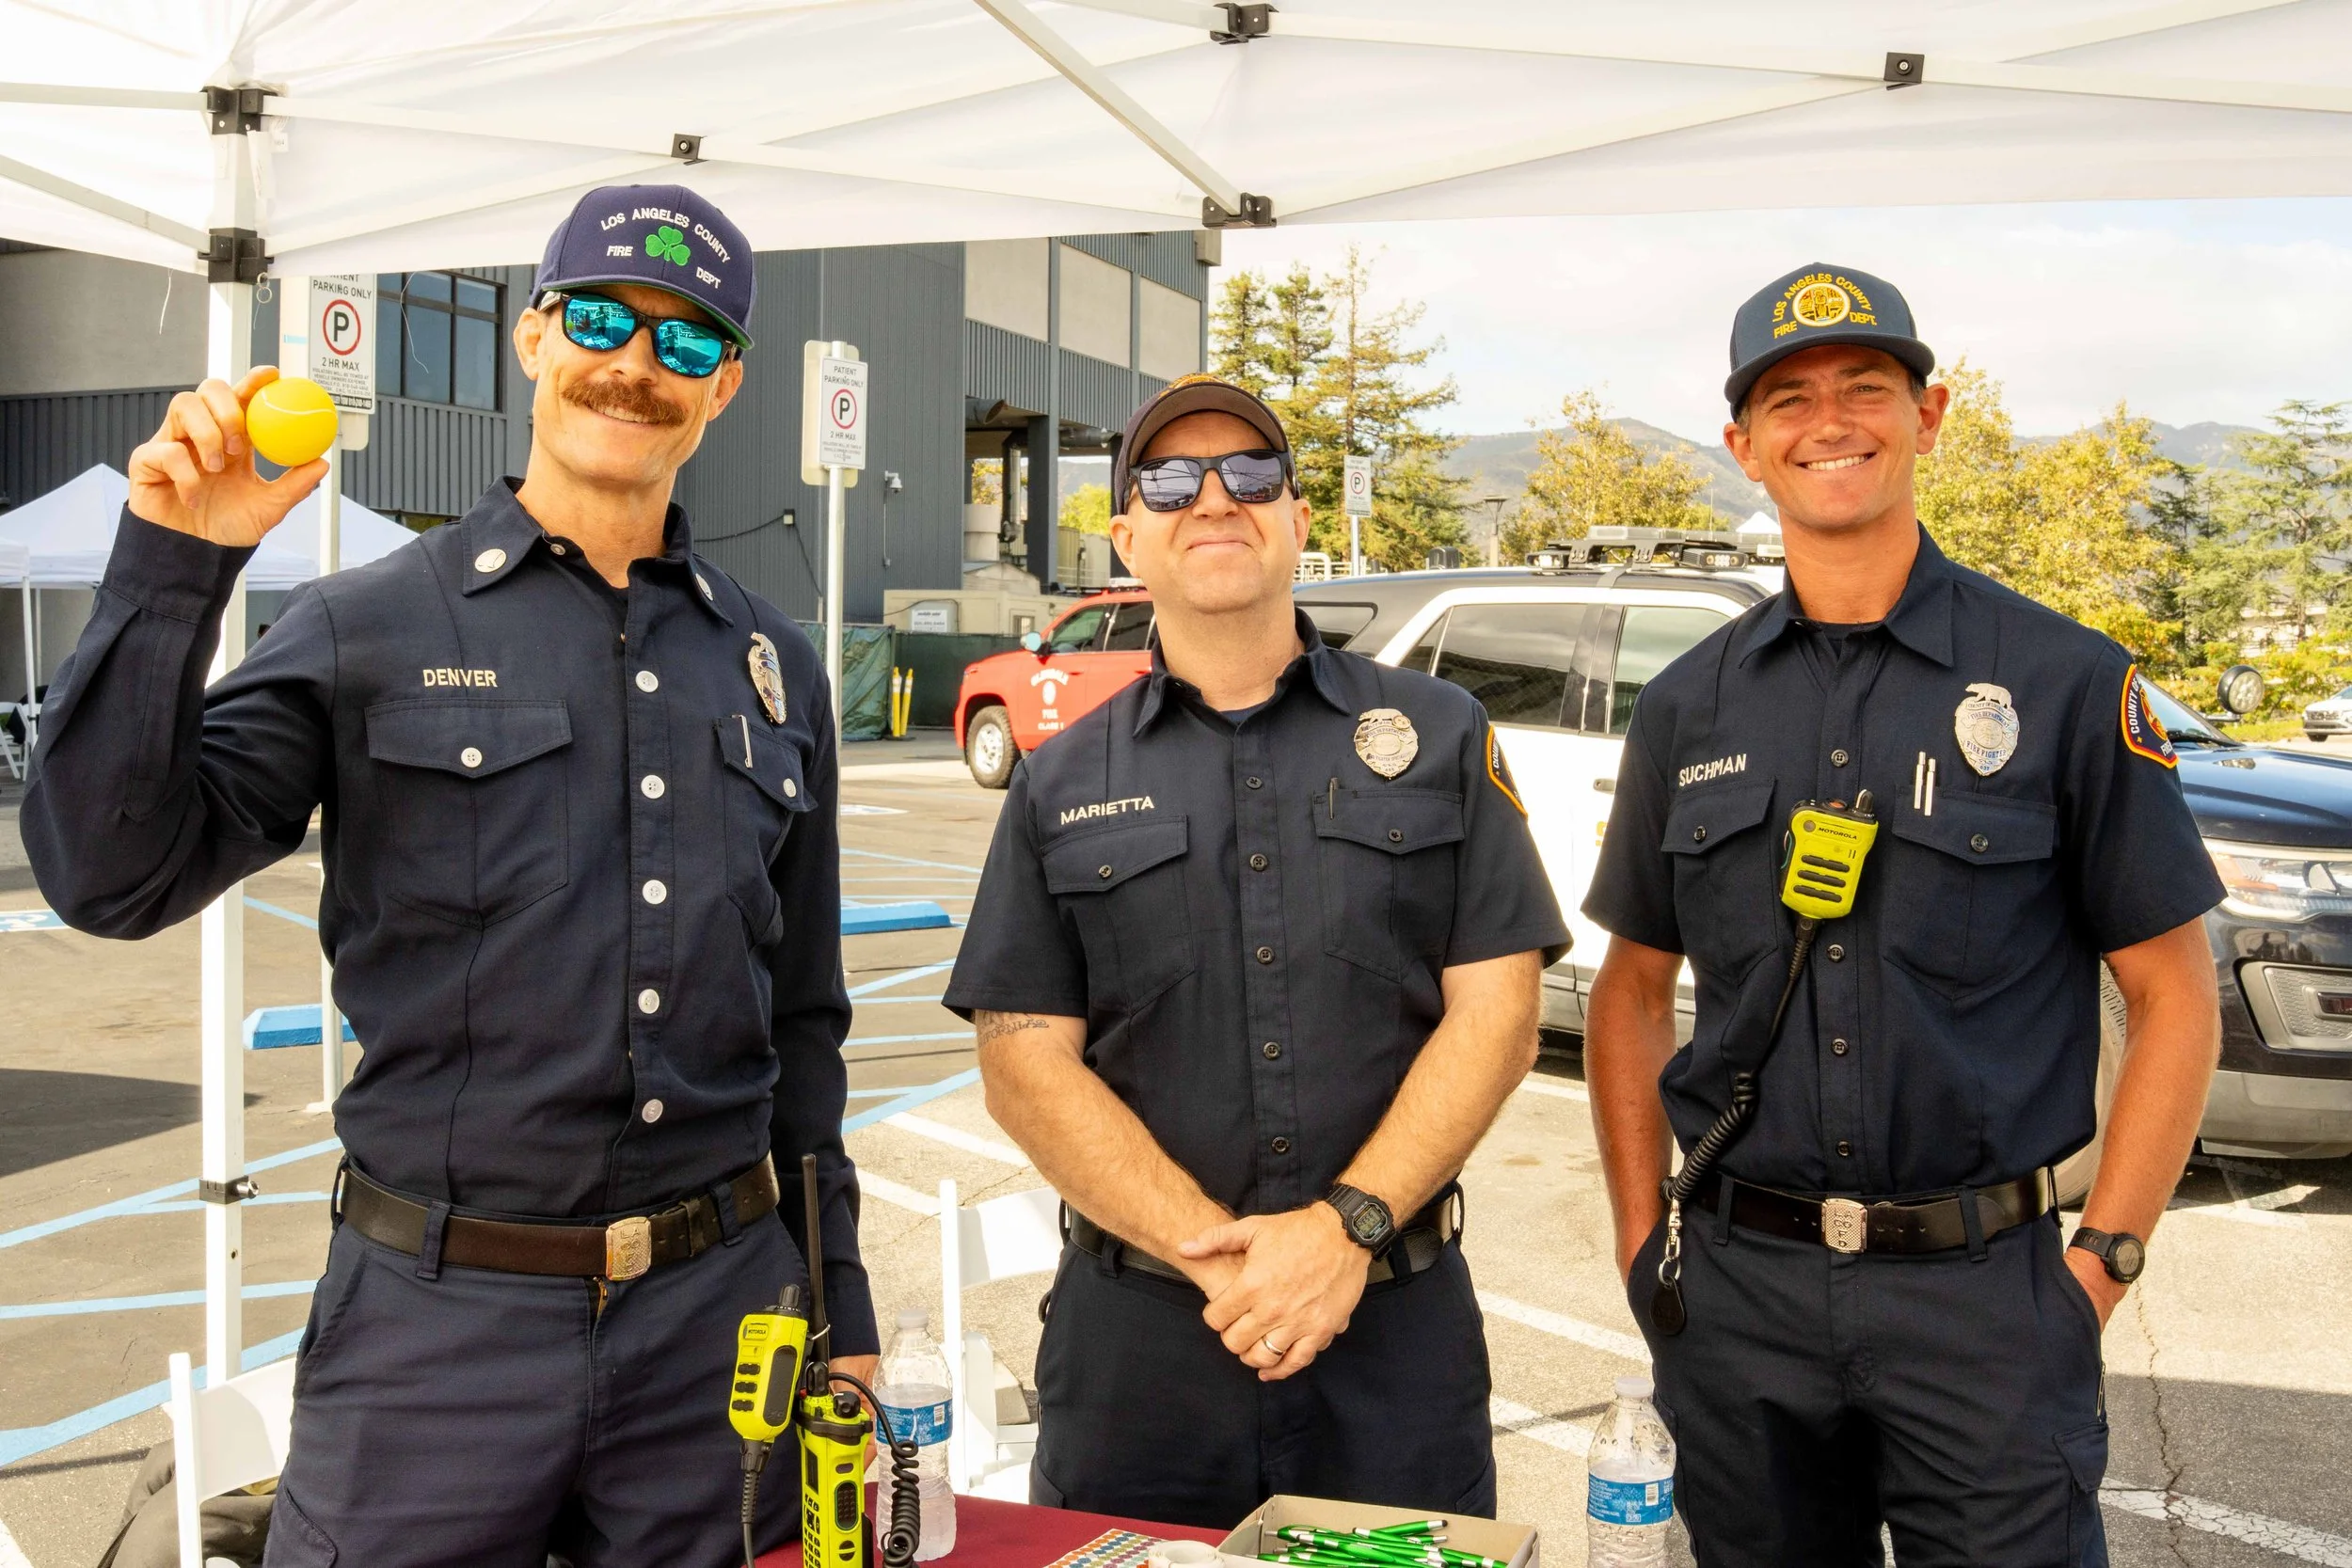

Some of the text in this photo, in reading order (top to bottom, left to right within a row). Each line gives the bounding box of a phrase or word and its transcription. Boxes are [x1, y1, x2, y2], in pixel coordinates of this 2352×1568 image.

[600, 208, 730, 263] LOS ANGELES COUNTY
[607, 245, 722, 289] FIRE DEPT
[312, 279, 372, 299] PARKING ONLY
[1772, 273, 1872, 323] LOS ANGELES COUNTY
[333, 310, 350, 342] P
[1773, 311, 1877, 339] FIRE DEPT.
[322, 356, 359, 372] 2 HR MAX
[834, 366, 857, 375] PATIENT
[824, 375, 849, 386] PARKING
[839, 397, 850, 420] P
[422, 669, 498, 688] DENVER
[2127, 689, 2140, 735] COUNTY
[1678, 753, 1747, 787] SUCHMAN
[1060, 796, 1154, 825] MARIETTA
[1819, 827, 1857, 840] MOTOROLA
